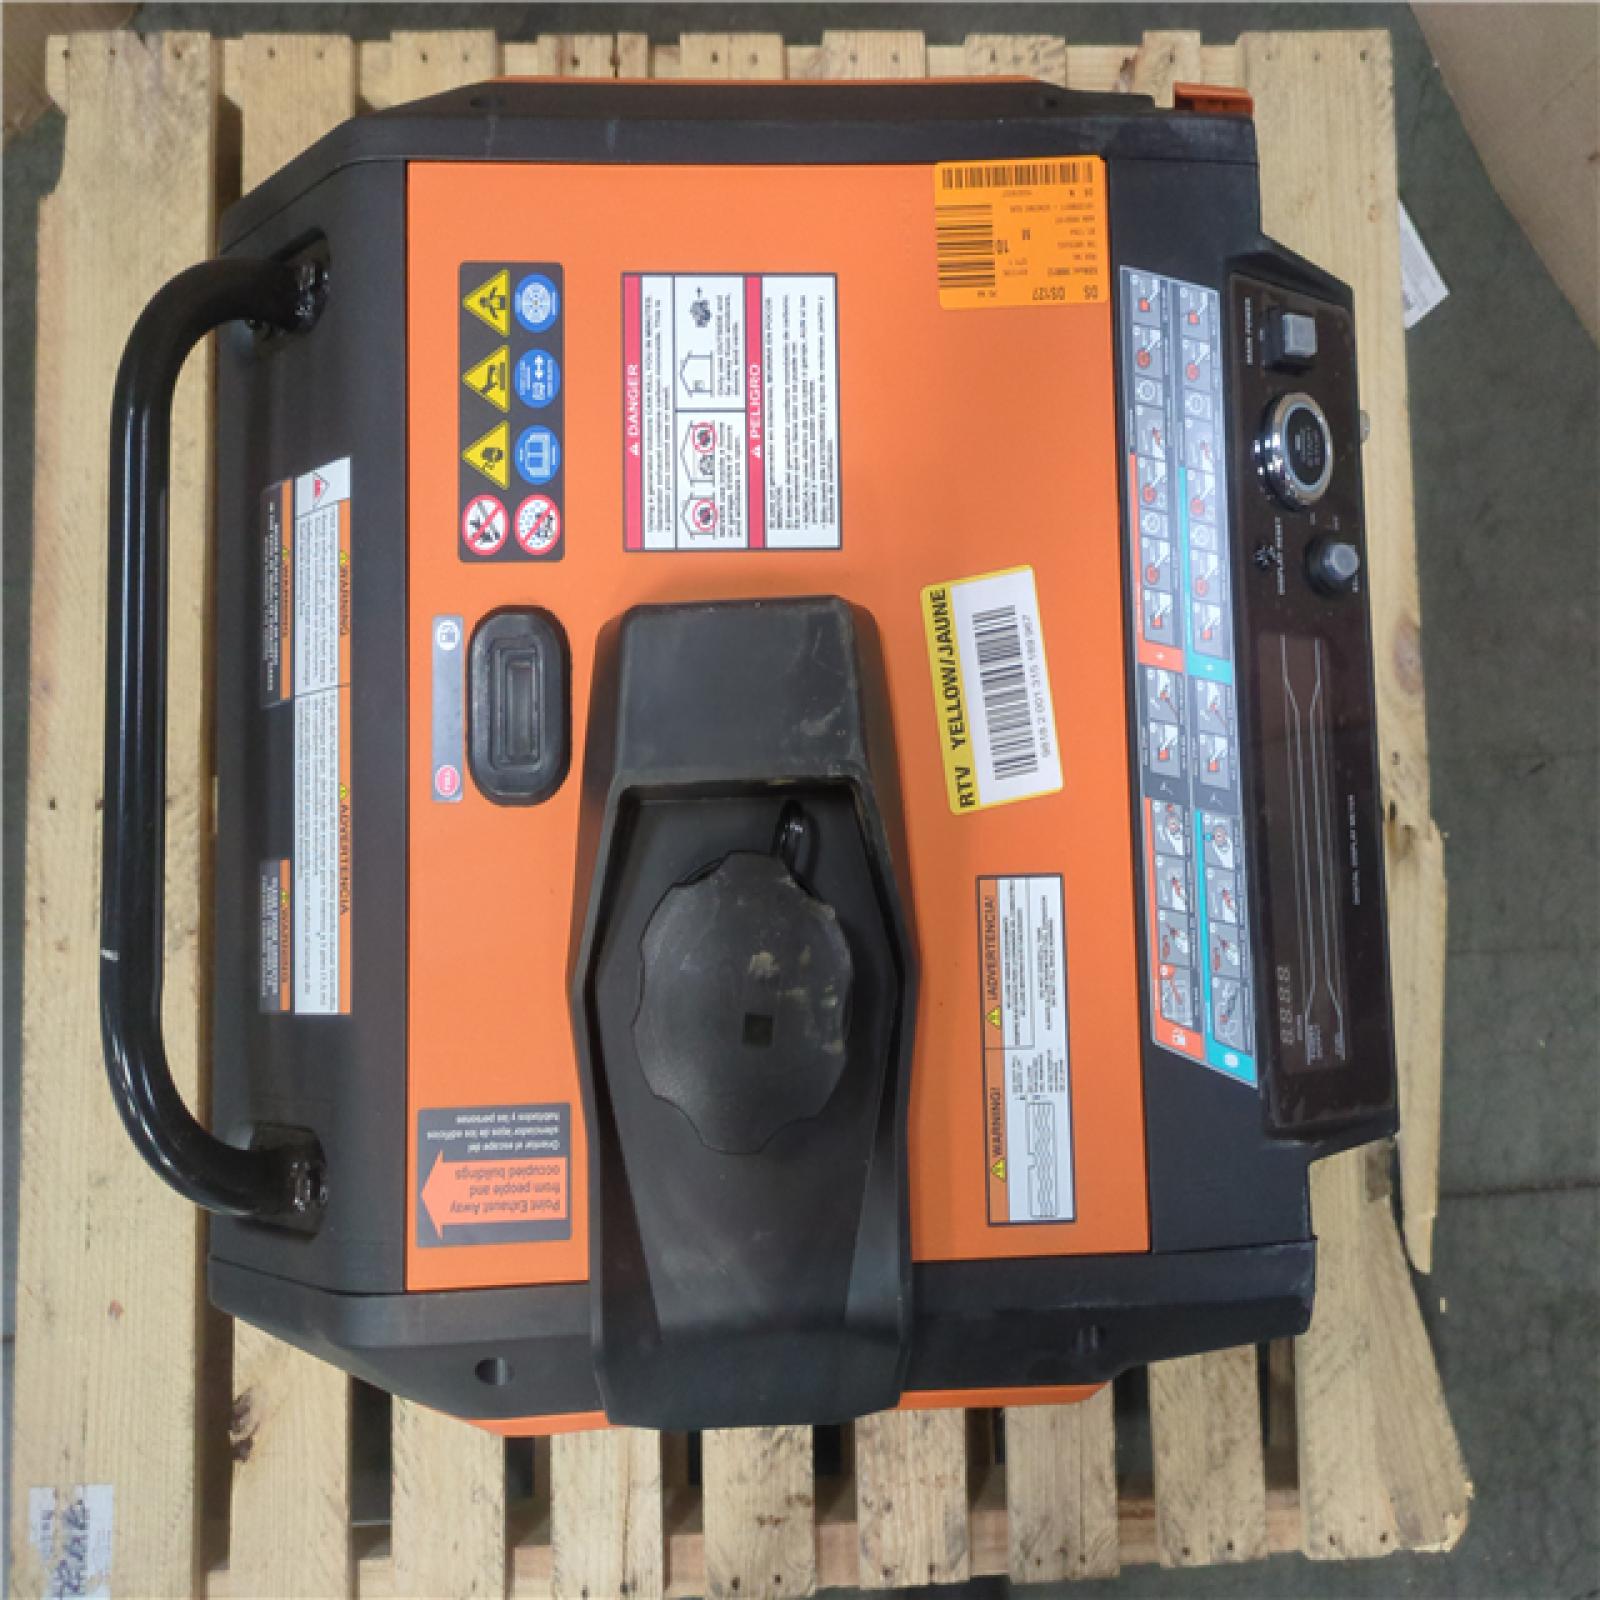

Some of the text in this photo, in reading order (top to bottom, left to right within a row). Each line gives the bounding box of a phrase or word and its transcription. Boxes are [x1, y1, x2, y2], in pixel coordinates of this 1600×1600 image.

[627, 364, 639, 436] DANGER
[750, 364, 761, 440] PELIGRO
[930, 588, 976, 808] RTV YELLOW/JAUNE
[340, 804, 349, 916] ADVERTENCIA
[990, 1087, 1003, 1157] WARNING!
[450, 1200, 560, 1215] Point Exhaust Away
[455, 1164, 560, 1180] occupied buildings
[469, 1182, 560, 1198] from people and
